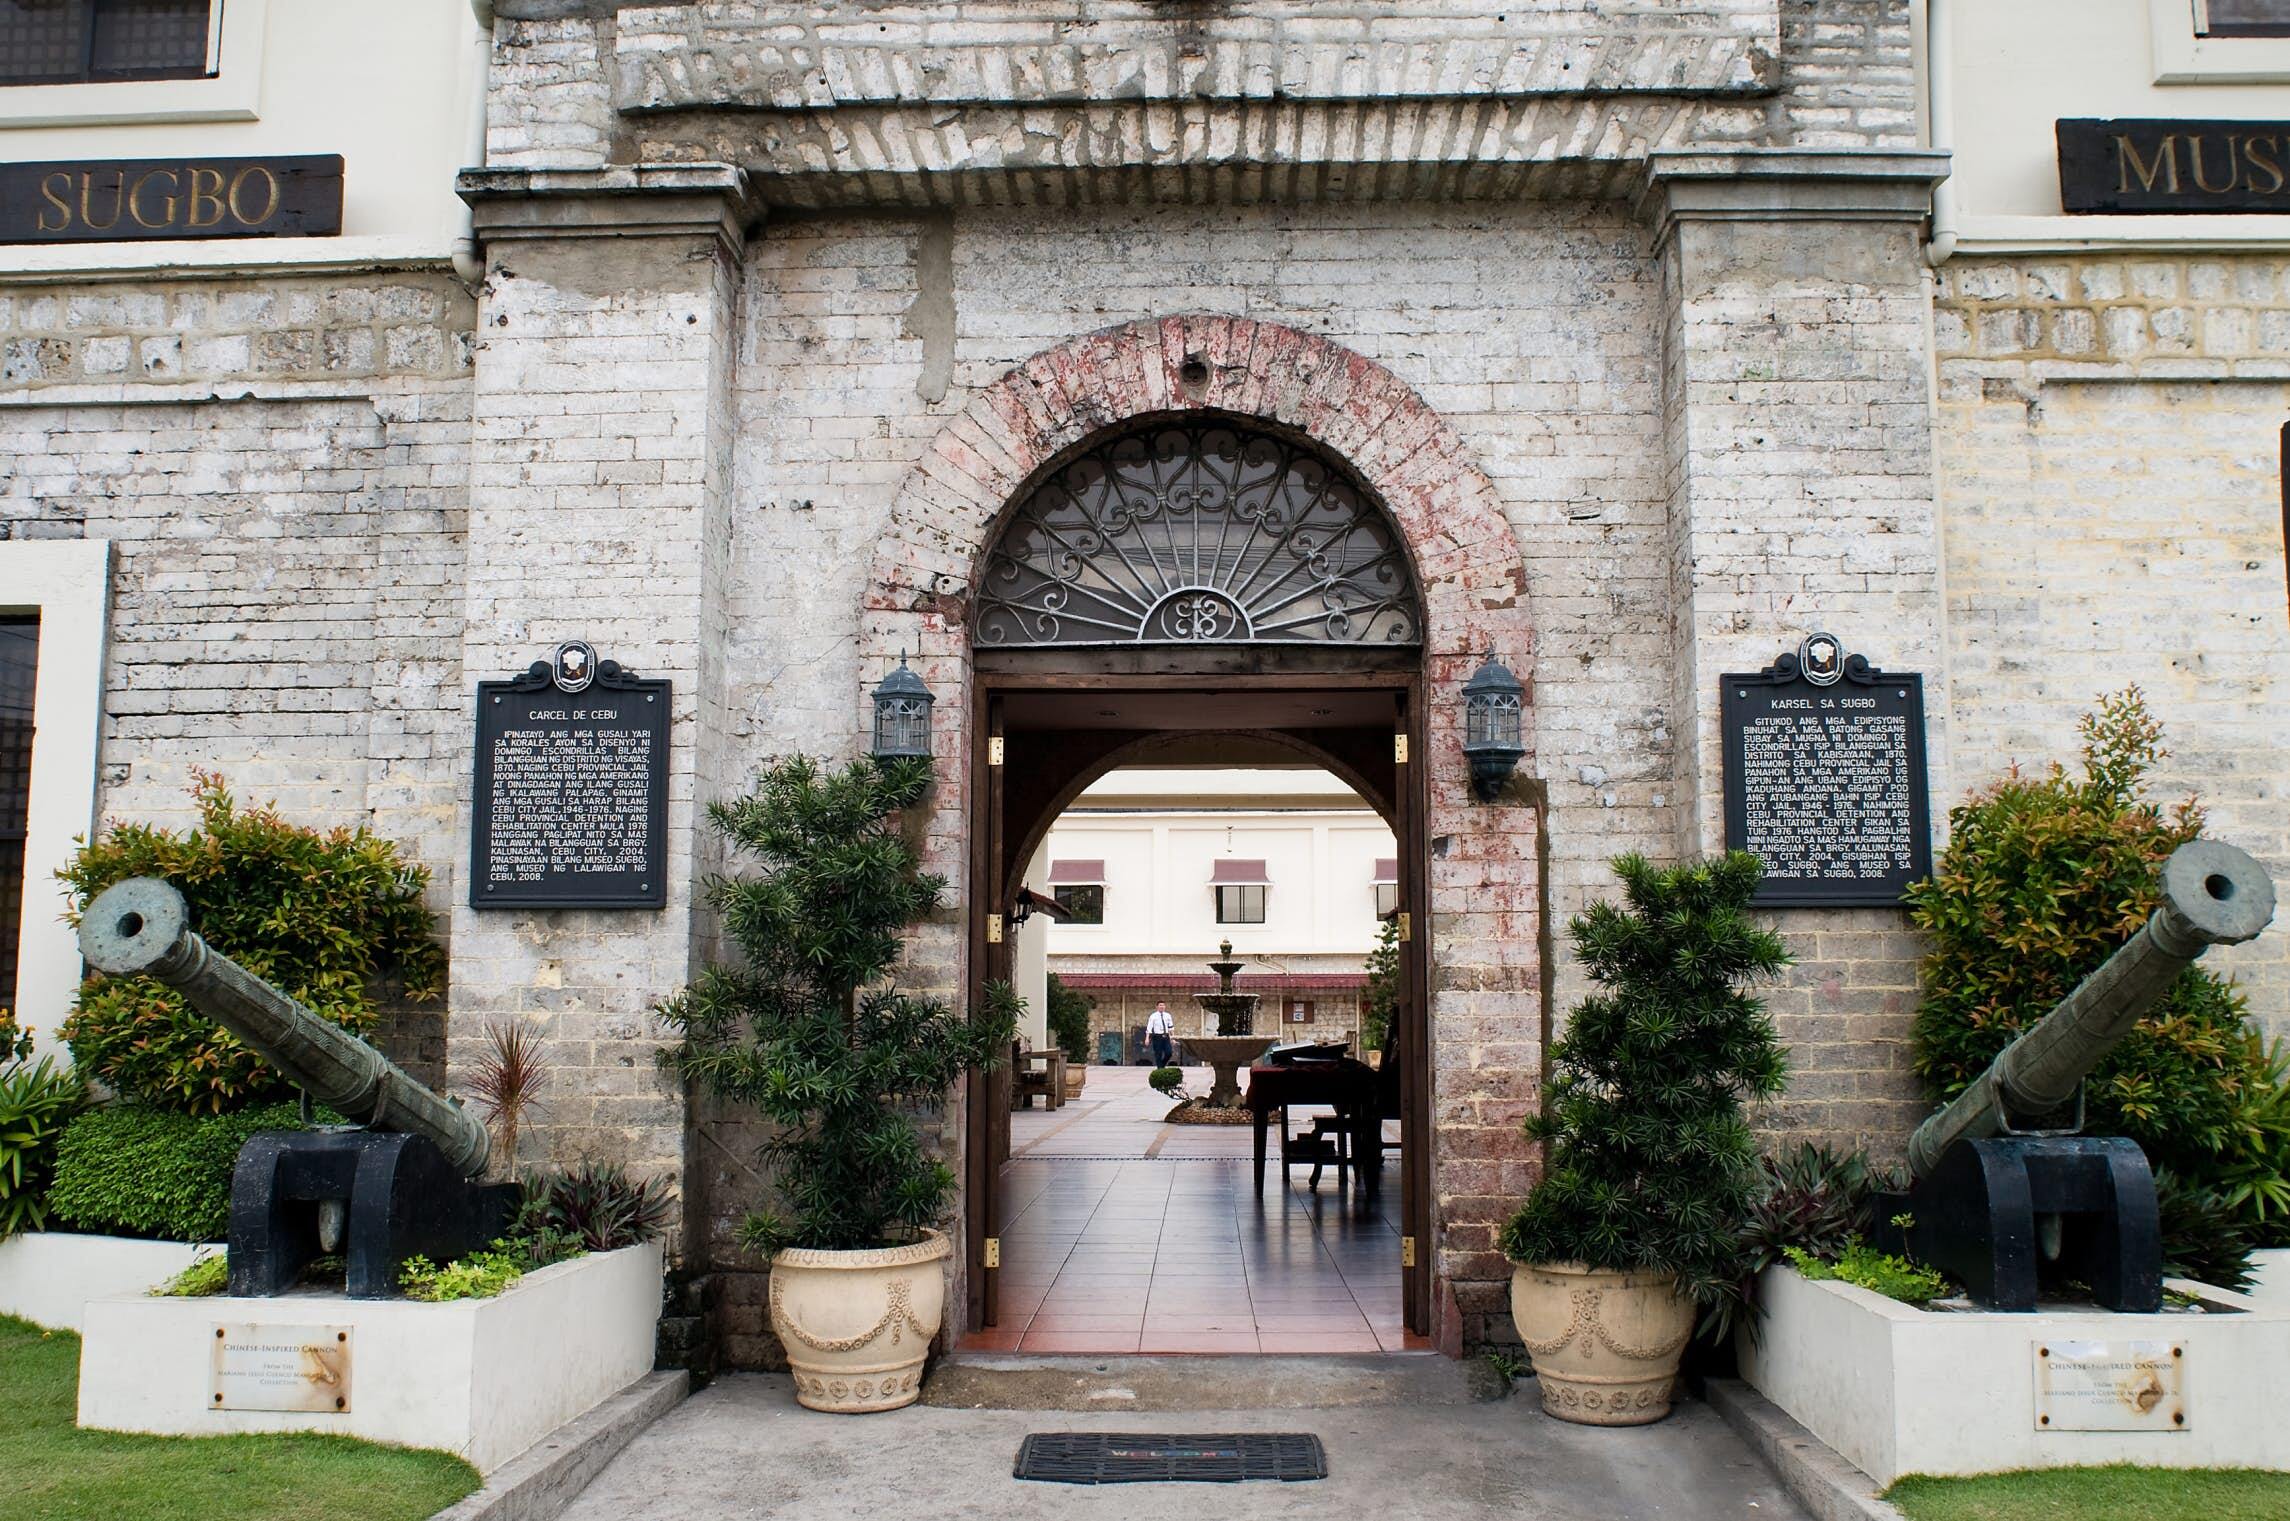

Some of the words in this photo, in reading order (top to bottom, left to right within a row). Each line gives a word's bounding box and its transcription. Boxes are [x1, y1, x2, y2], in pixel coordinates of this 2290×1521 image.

[2111, 133, 2290, 194] MUS
[36, 166, 280, 232] SUGBO
[530, 711, 568, 719] CARCEL
[573, 711, 586, 719] DE
[591, 711, 617, 719] CEBU
[1772, 700, 1813, 708] KARSEL
[1820, 700, 1835, 708] SA
[1841, 699, 1875, 708] SUGBO
